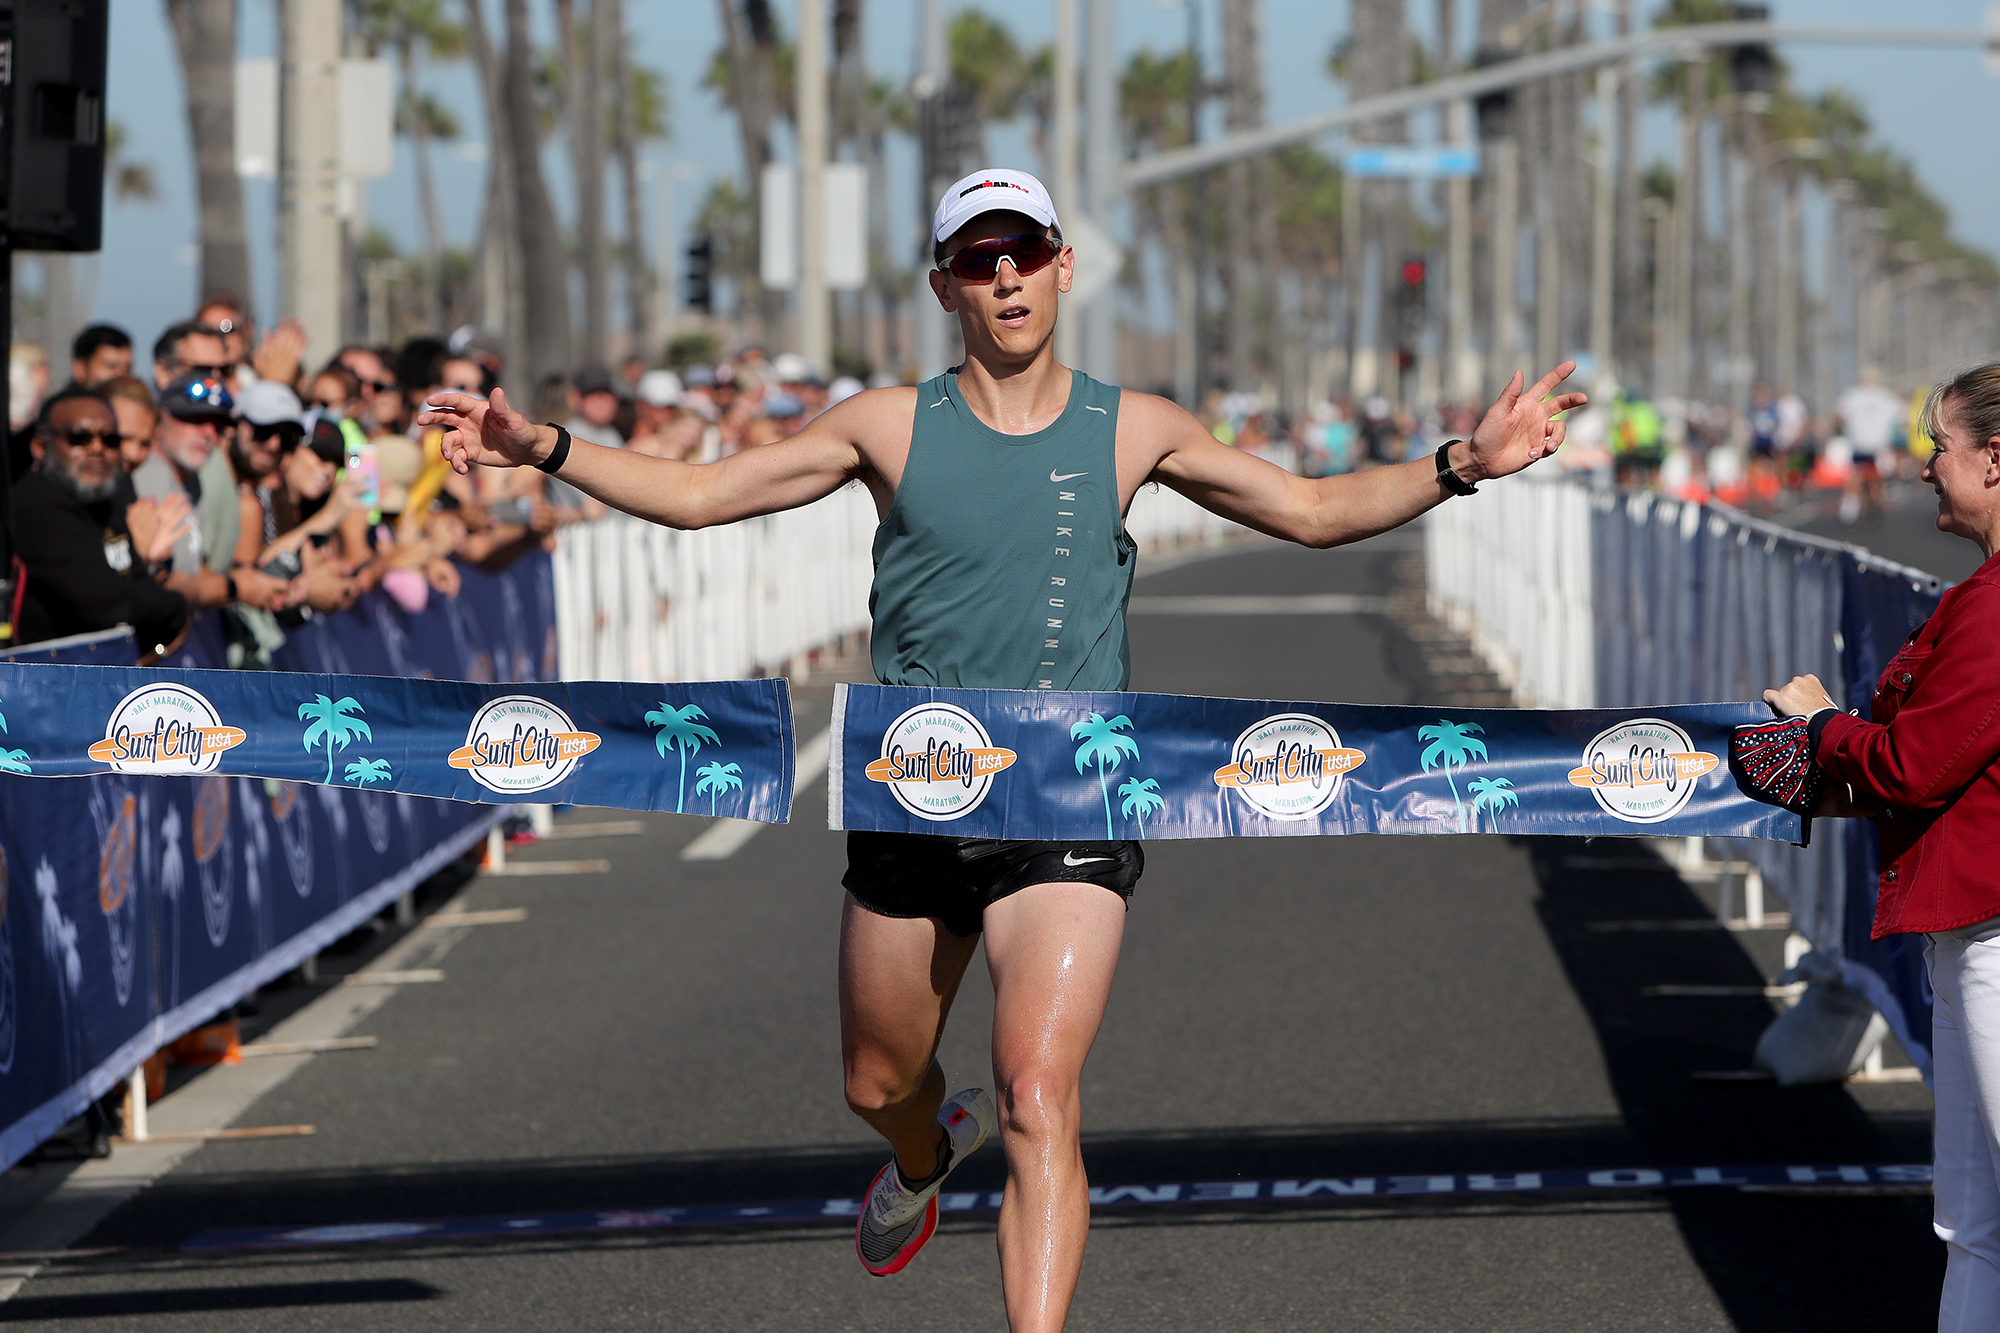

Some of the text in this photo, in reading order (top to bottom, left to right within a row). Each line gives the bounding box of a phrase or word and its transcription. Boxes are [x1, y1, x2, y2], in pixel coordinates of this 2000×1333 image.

[1038, 491, 1076, 690] NIKE RUNNIN
[132, 696, 194, 715] HALF MARATHON
[491, 706, 549, 723] HALF MARATHON
[904, 716, 965, 735] HALF MARATHON
[1257, 724, 1317, 741] HALF MARATHON
[206, 732, 232, 748] USA
[1609, 729, 1670, 744] HALF MARATHON
[562, 737, 588, 754] USA
[977, 753, 1003, 770] USA
[1326, 753, 1352, 770] USA
[1680, 757, 1706, 774] USA
[501, 774, 541, 785] MARATHON
[922, 794, 962, 808] MARATHON
[1273, 794, 1314, 808] MARATHON
[1624, 798, 1665, 812] MARATHON
[1587, 1167, 1748, 1187] TO
